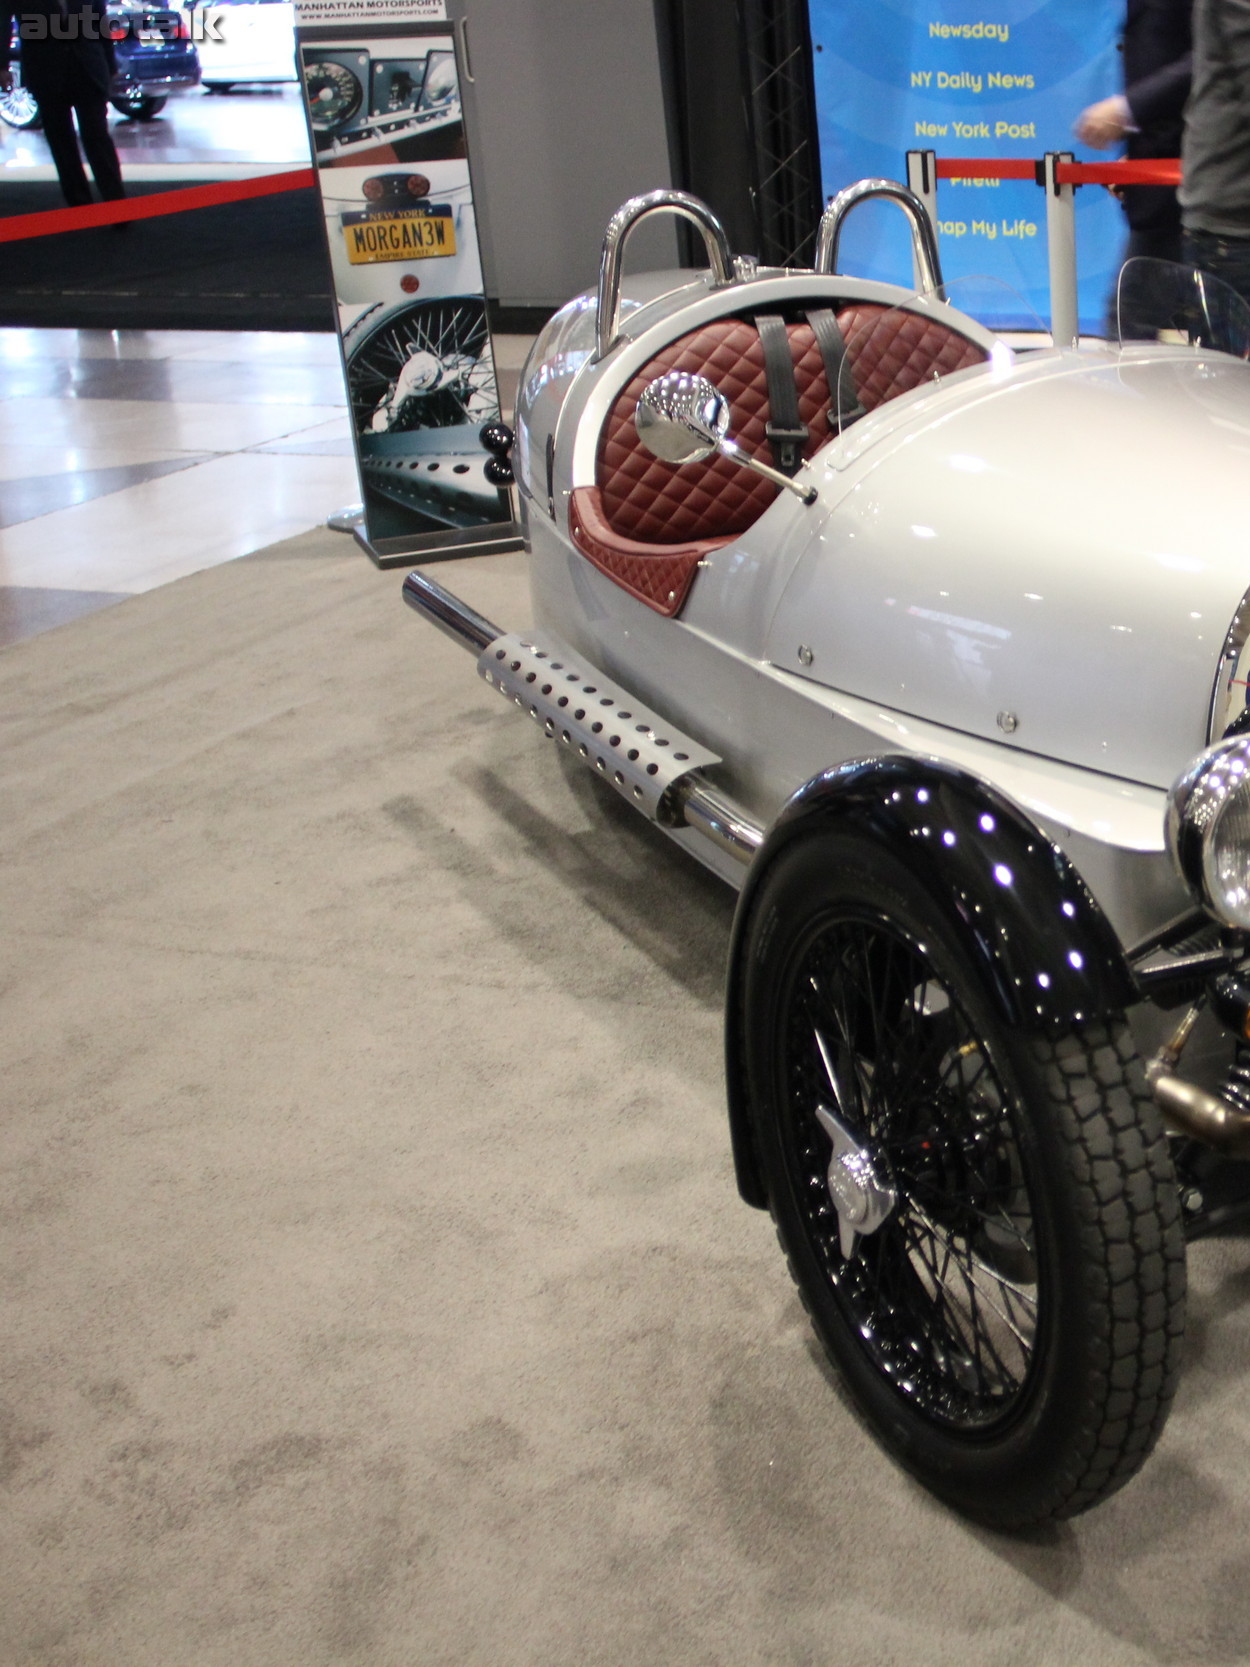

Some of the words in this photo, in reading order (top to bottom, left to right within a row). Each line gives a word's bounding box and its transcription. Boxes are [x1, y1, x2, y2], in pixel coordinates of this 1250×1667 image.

[295, 2, 363, 11] MANHATTAN
[366, 0, 442, 8] MOTORSPORTS
[929, 21, 1009, 42] Newsday
[910, 71, 932, 88] NY
[937, 71, 982, 93] Daily
[988, 72, 1035, 89] News
[915, 121, 948, 137] New
[952, 122, 990, 138] York
[995, 121, 1036, 138] Post
[353, 220, 445, 253] MORGAN3W
[972, 220, 997, 239] My
[1002, 219, 1037, 239] Life
